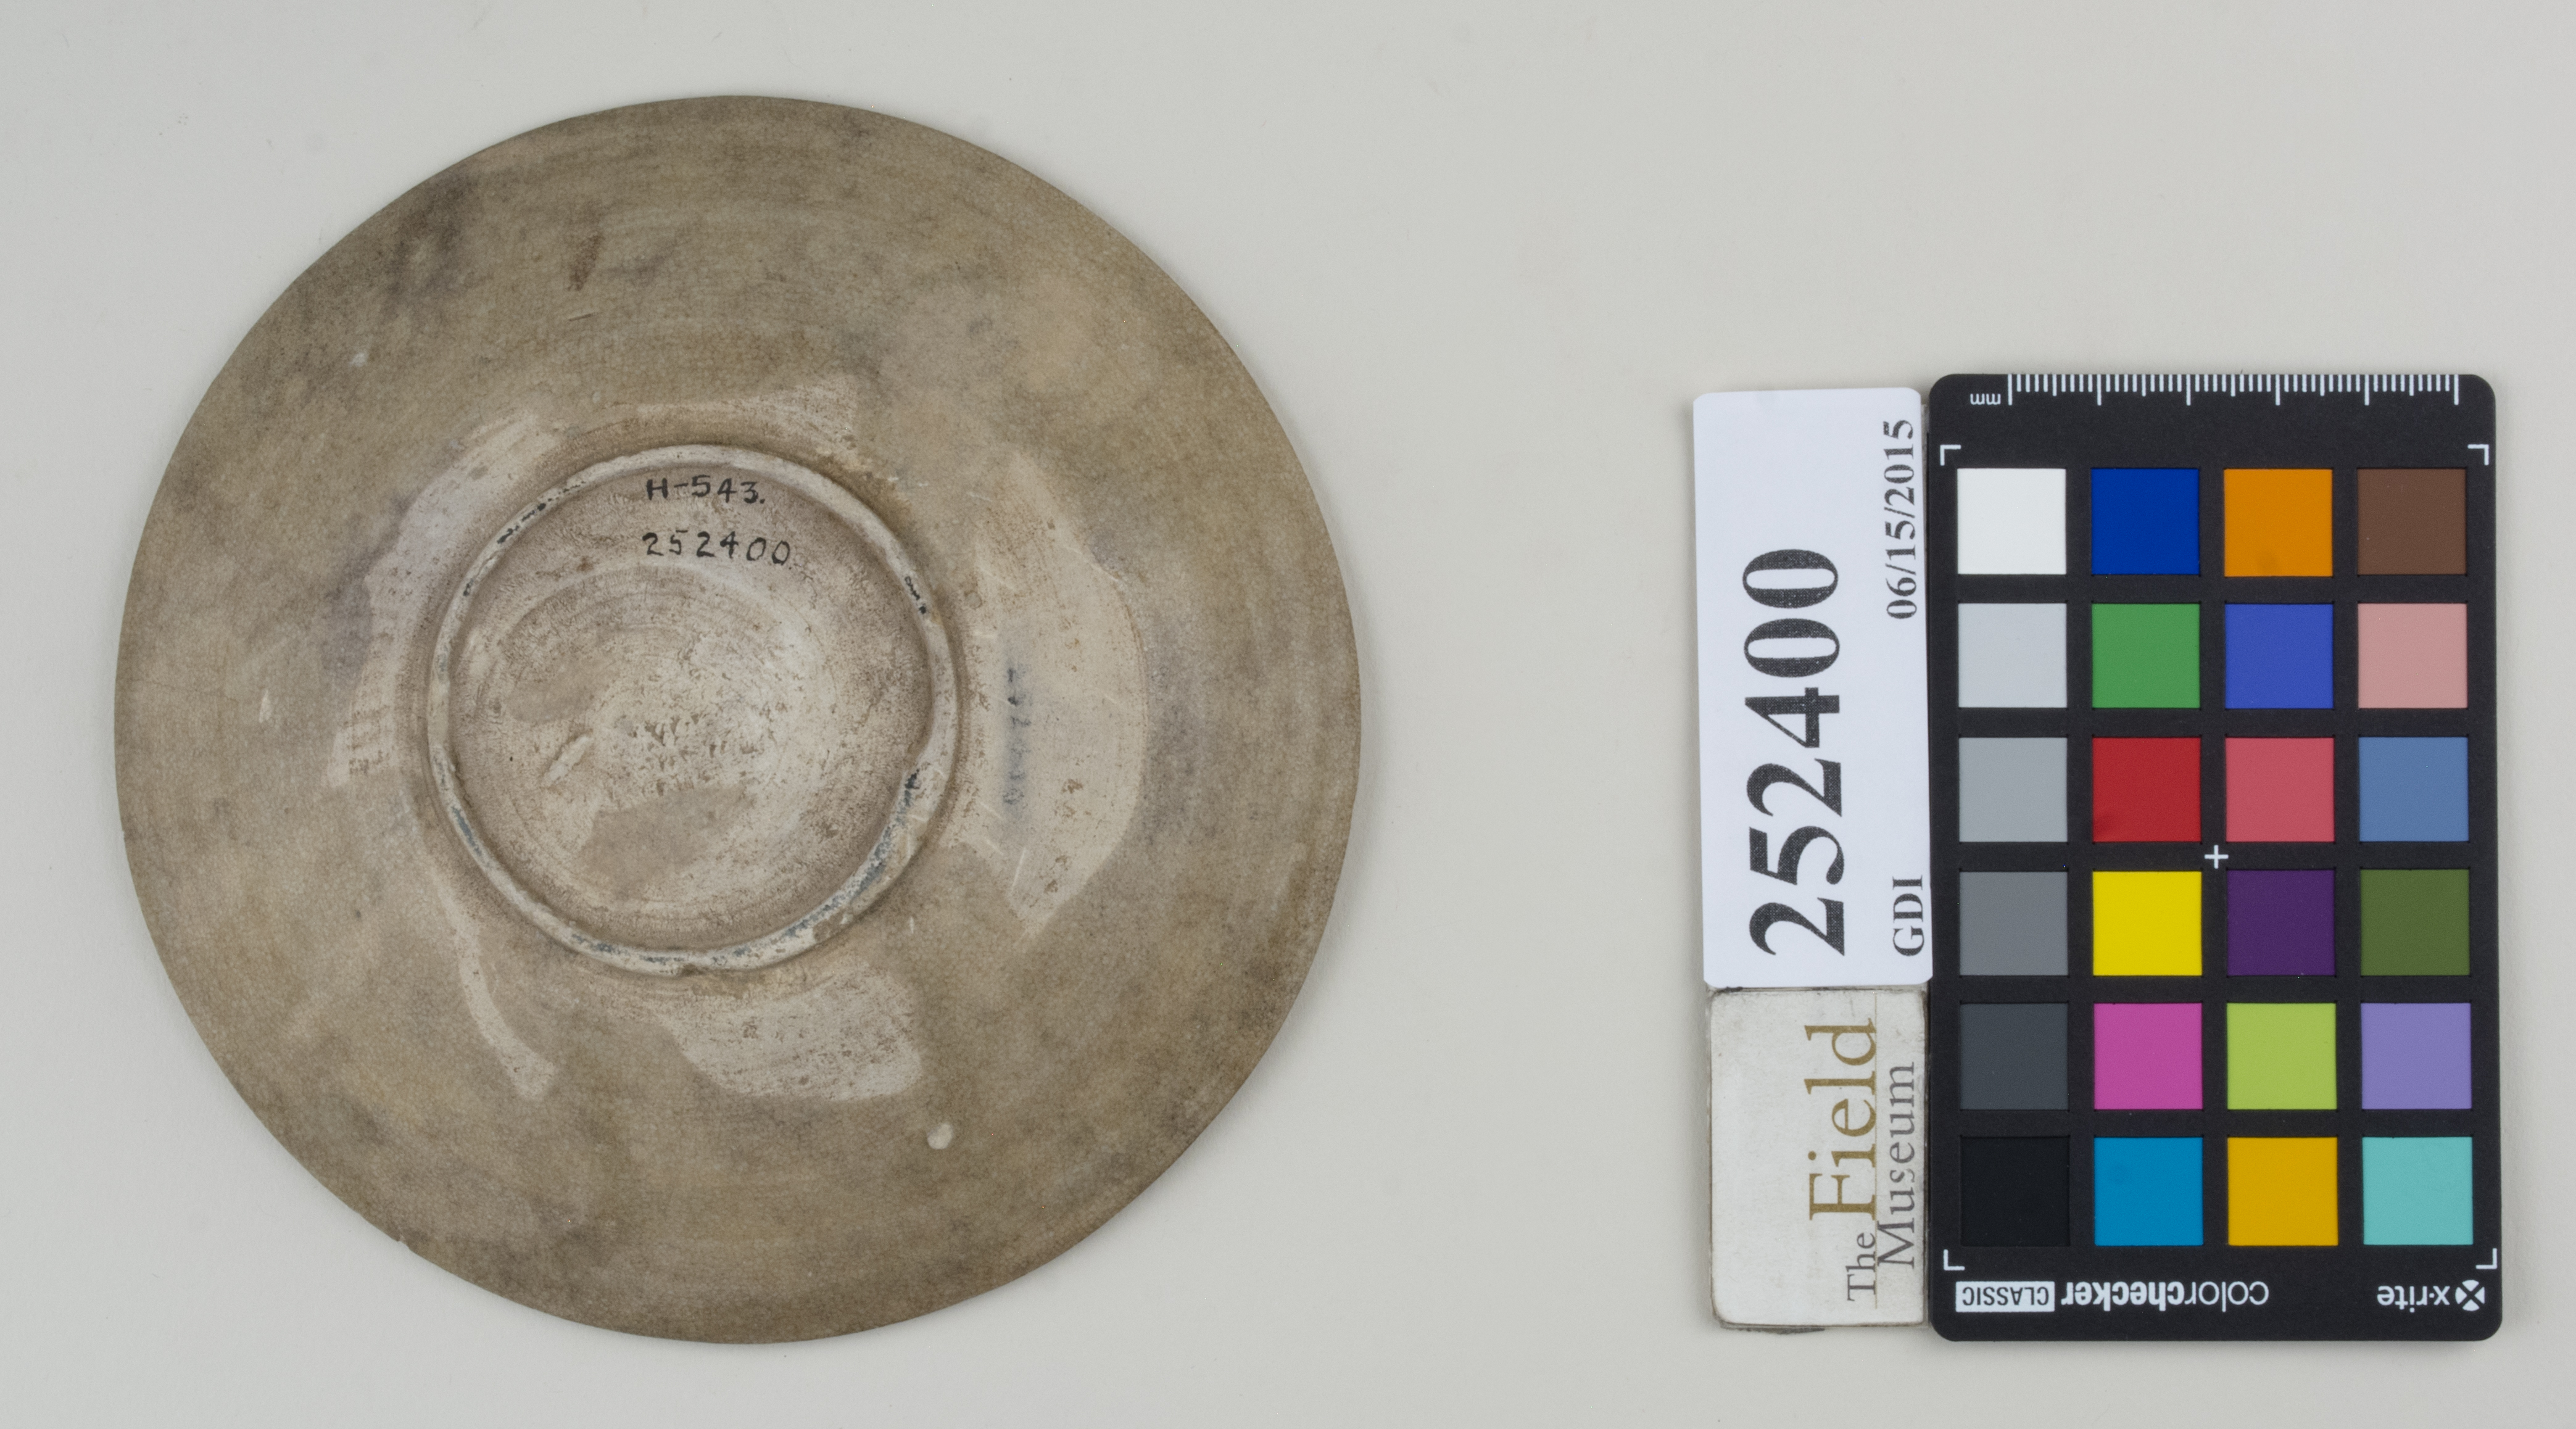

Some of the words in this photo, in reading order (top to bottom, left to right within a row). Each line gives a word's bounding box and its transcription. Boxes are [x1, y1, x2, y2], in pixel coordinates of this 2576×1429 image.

[1969, 393, 2002, 405] mm
[642, 529, 790, 566] 252400
[1883, 419, 1917, 619] 06/15/2015
[1742, 548, 1845, 956] 252400
[1892, 876, 1924, 957] GDI
[1804, 1017, 1877, 1221] Field
[1876, 1061, 1915, 1270] Museum
[1845, 1232, 1876, 1302] The
[1962, 1286, 2049, 1306] CLASSIC
[2060, 1281, 2269, 1313] colorchecker
